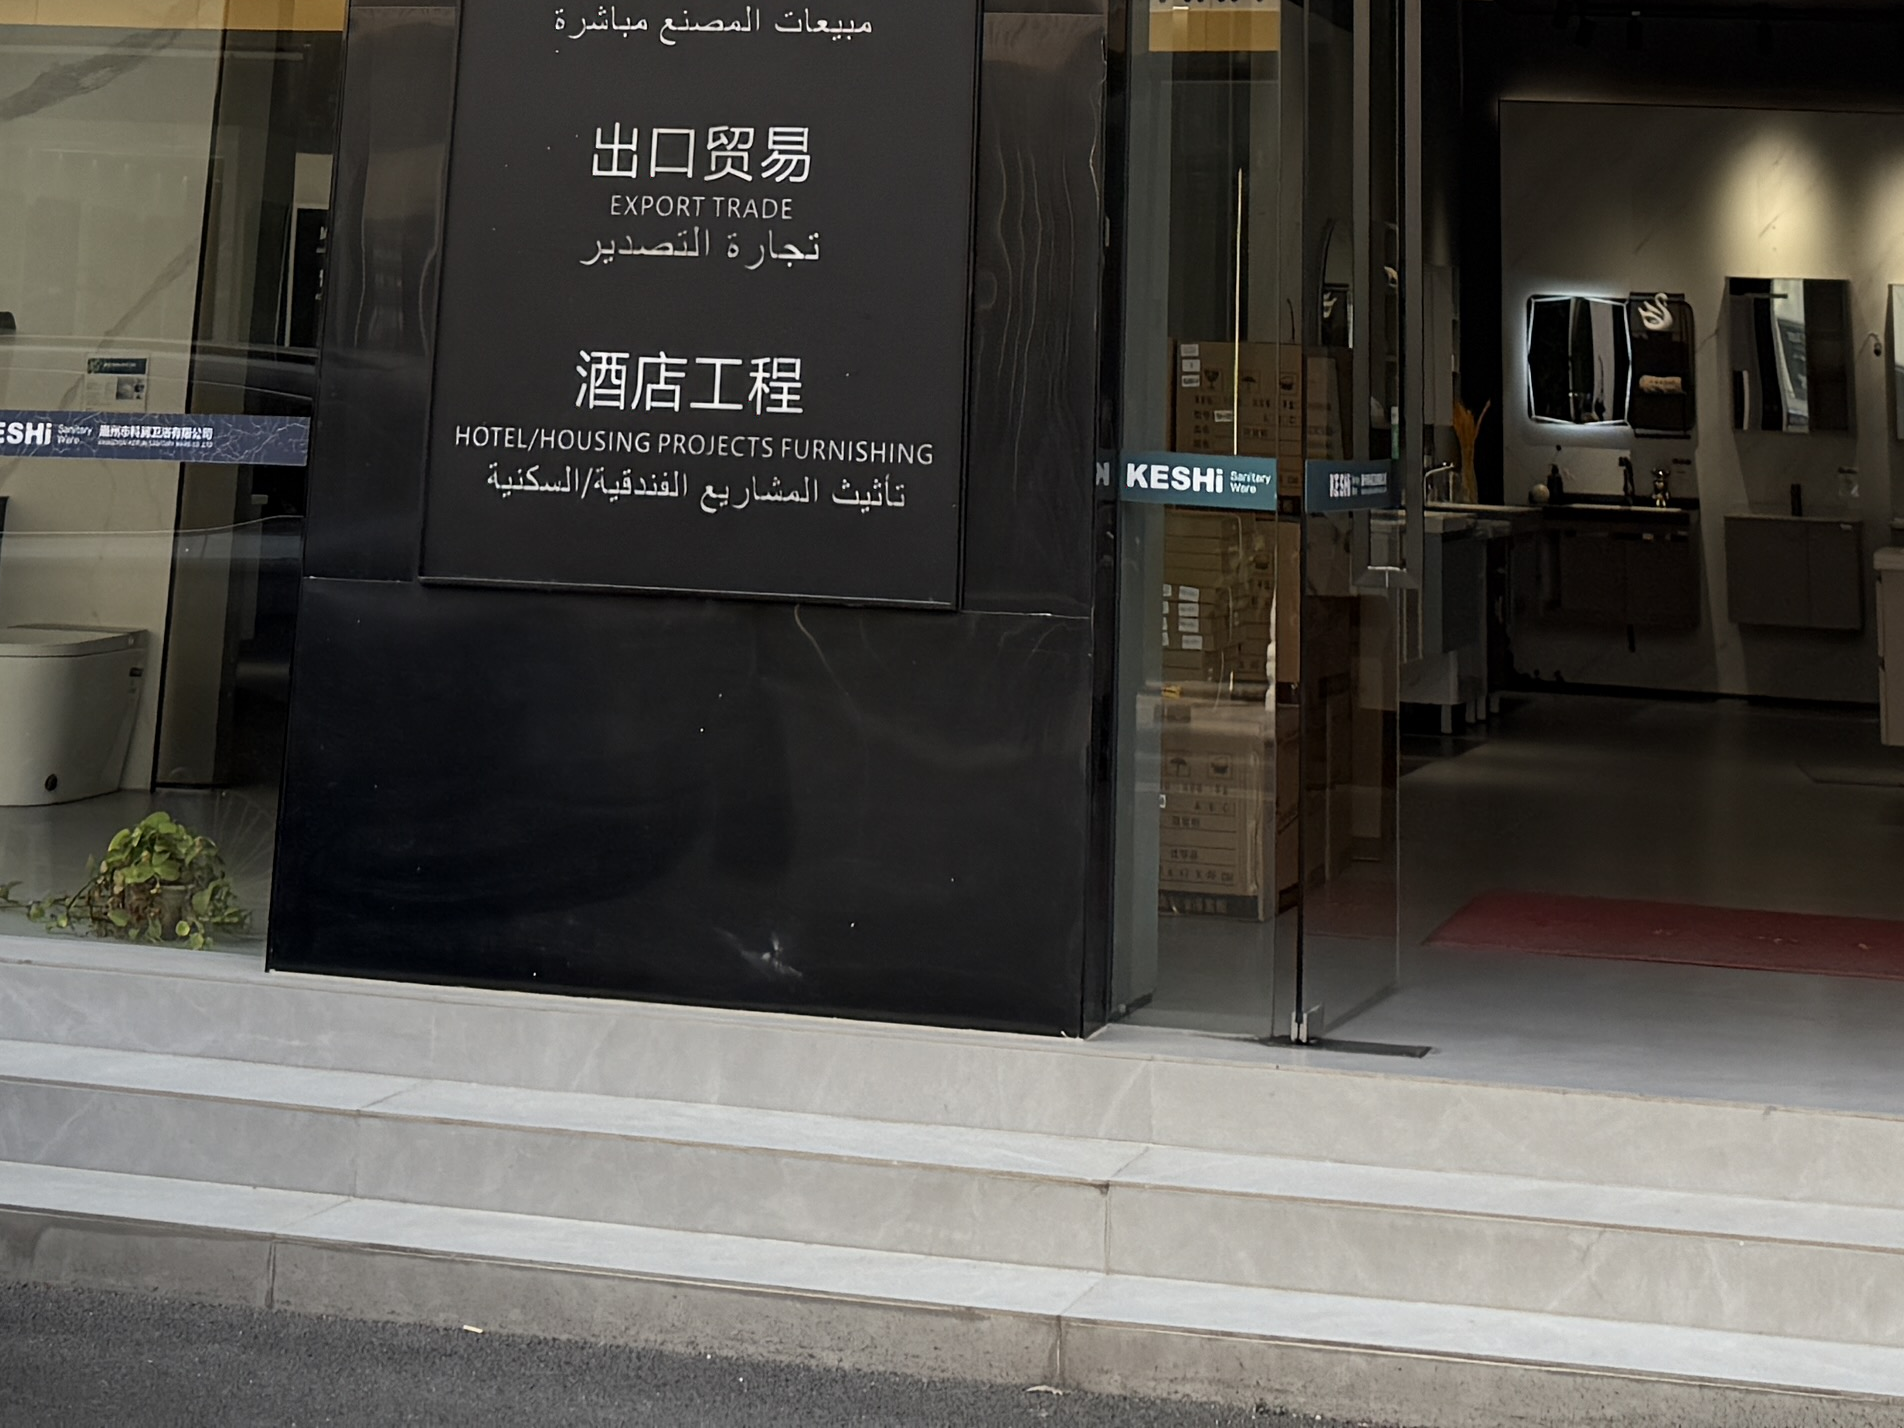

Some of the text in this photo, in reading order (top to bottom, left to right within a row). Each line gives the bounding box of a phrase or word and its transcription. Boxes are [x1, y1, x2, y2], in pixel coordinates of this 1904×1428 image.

[555, 5, 872, 46] مبيعات المصنع مباشرة
[592, 122, 811, 183] 出口贸易
[610, 194, 793, 220] EXPORT TRADE
[579, 226, 821, 270] تجارة التصدير
[575, 350, 804, 415] 酒店工程
[58, 424, 94, 436] Sanitary
[455, 425, 934, 465] HOTEL/HOUSING PROJECTS FURNISHING
[700, 476, 818, 514] المشاريع
[832, 474, 907, 514] تأثيث
[1126, 463, 1224, 494] KESHi
[1230, 470, 1272, 485] Sanitary
[1230, 482, 1257, 494] Ware
